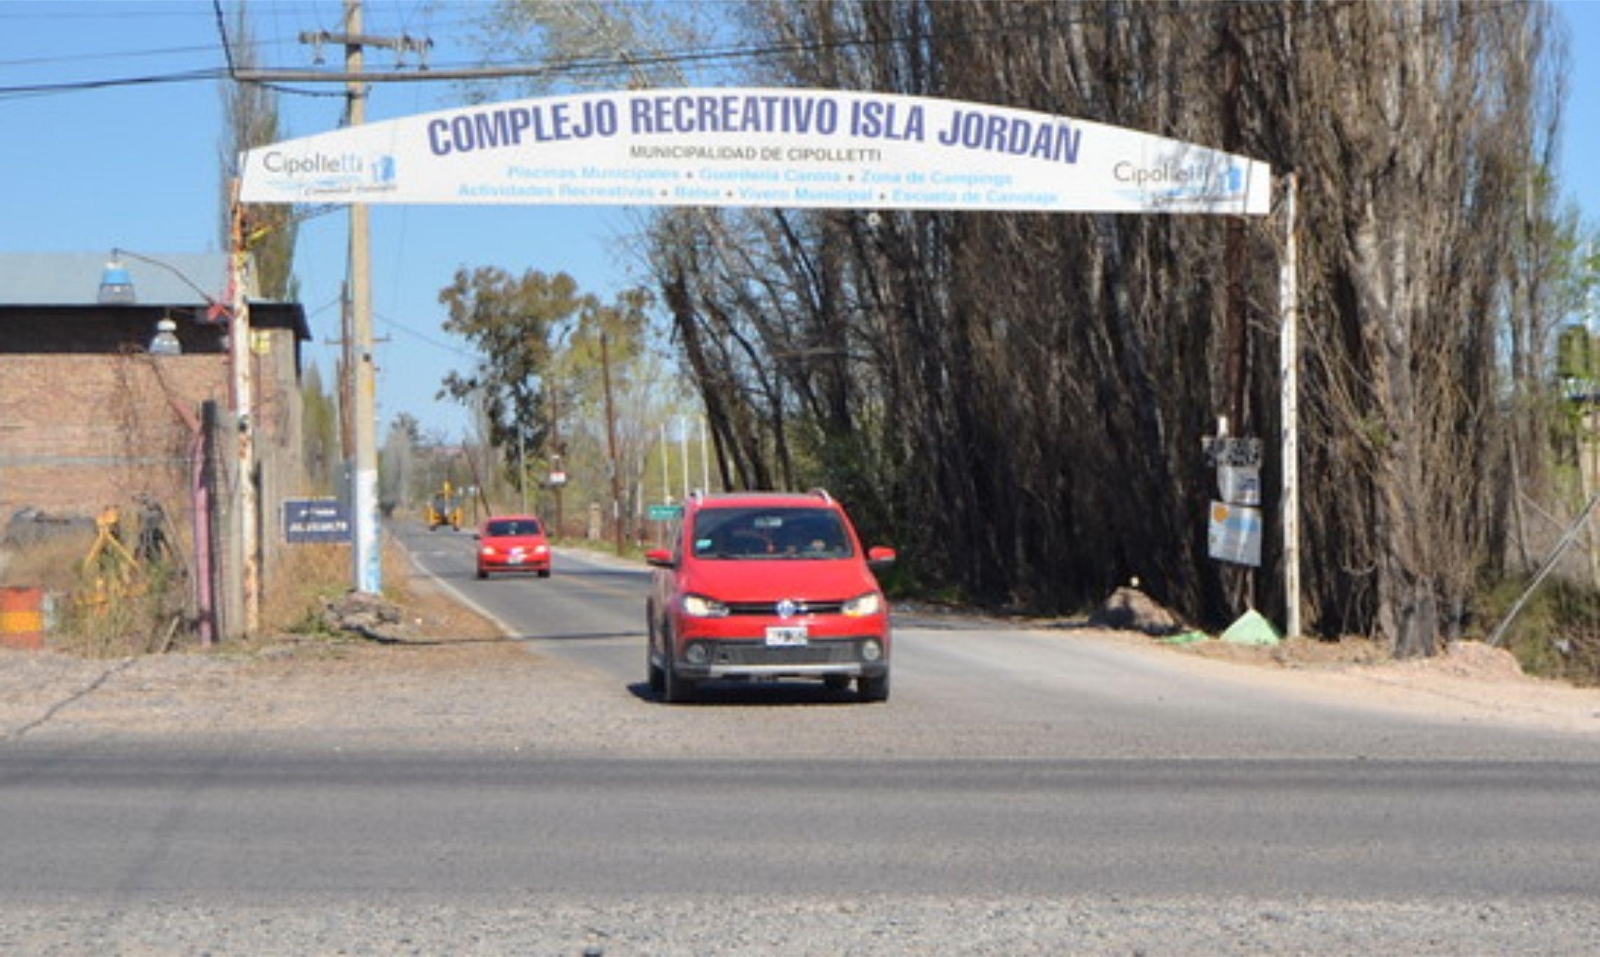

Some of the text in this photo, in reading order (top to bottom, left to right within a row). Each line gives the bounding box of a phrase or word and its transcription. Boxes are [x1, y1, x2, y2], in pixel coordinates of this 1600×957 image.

[428, 99, 618, 156] COMPLEJO
[631, 96, 838, 135] RECREATIVO
[850, 101, 924, 141] ISLA
[263, 151, 364, 176] Cipolletti
[629, 146, 882, 162] MUNICIPALIDAD DE CIPOLLETTI
[508, 166, 576, 179] Piscinas
[582, 166, 679, 181] Municipales
[860, 169, 902, 184] Zona
[906, 171, 925, 184] de
[1113, 161, 1210, 185] Cipolletti
[458, 184, 554, 196] Actividades
[559, 184, 653, 197] Recreativas
[738, 186, 790, 200] Vivero
[795, 187, 872, 202] Municipal
[892, 188, 957, 203] Escuela
[961, 190, 981, 203] de
